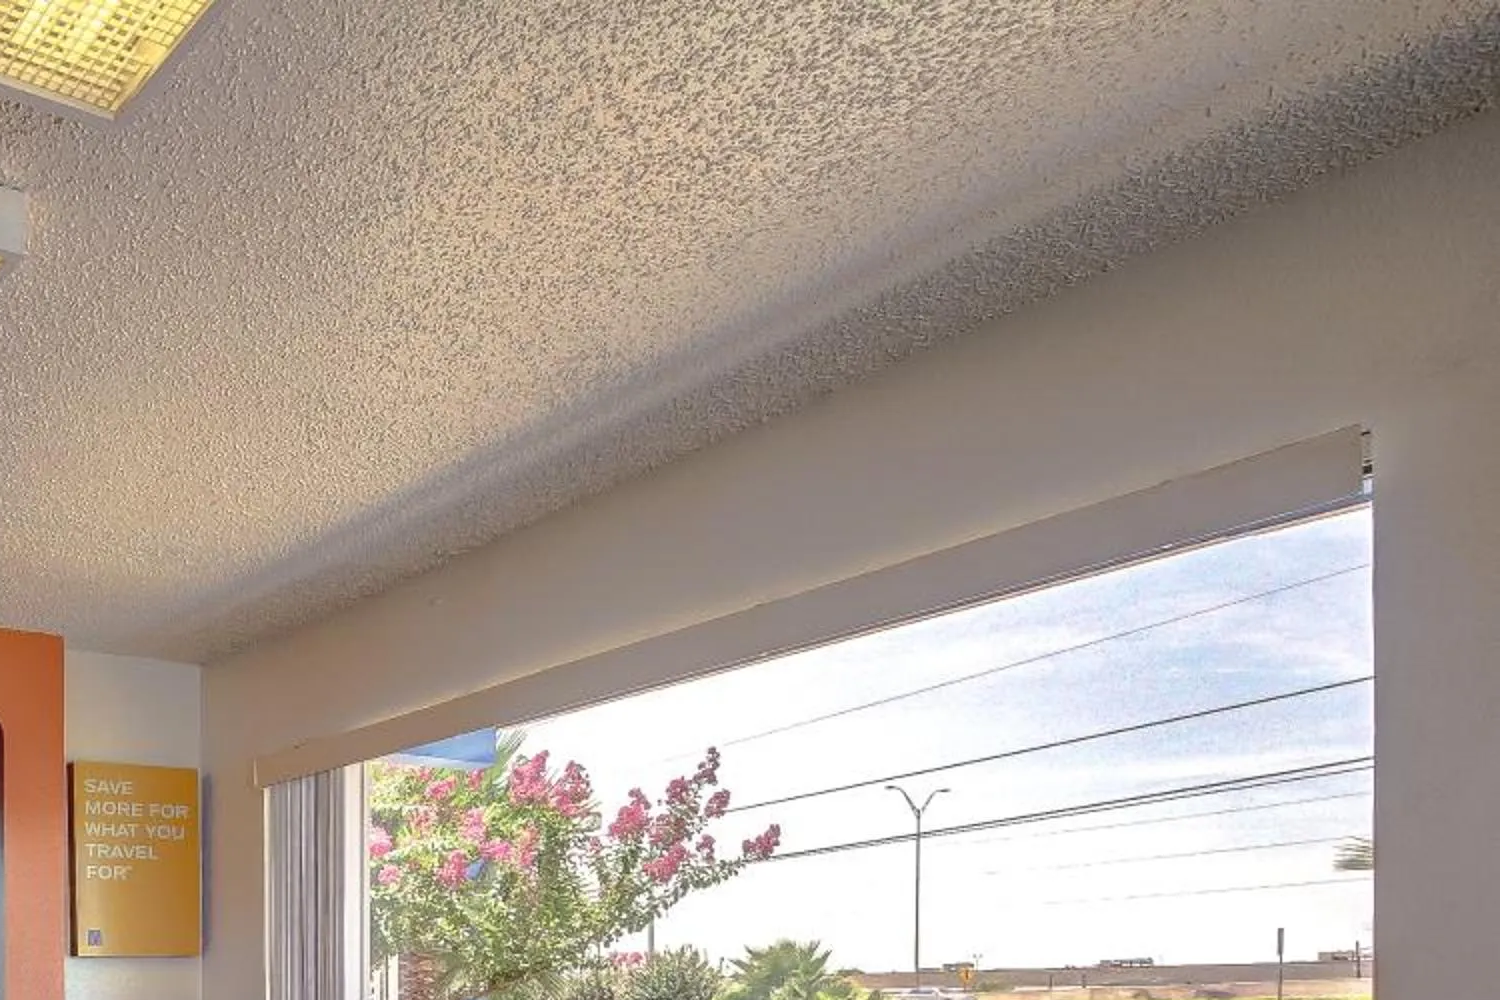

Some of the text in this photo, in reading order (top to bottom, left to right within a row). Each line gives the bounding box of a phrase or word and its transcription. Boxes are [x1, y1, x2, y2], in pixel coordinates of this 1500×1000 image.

[84, 779, 133, 796] SAVE
[84, 802, 188, 819] MORE FOR
[84, 822, 185, 841] WHAT YOU
[85, 843, 158, 860] TRAVEL
